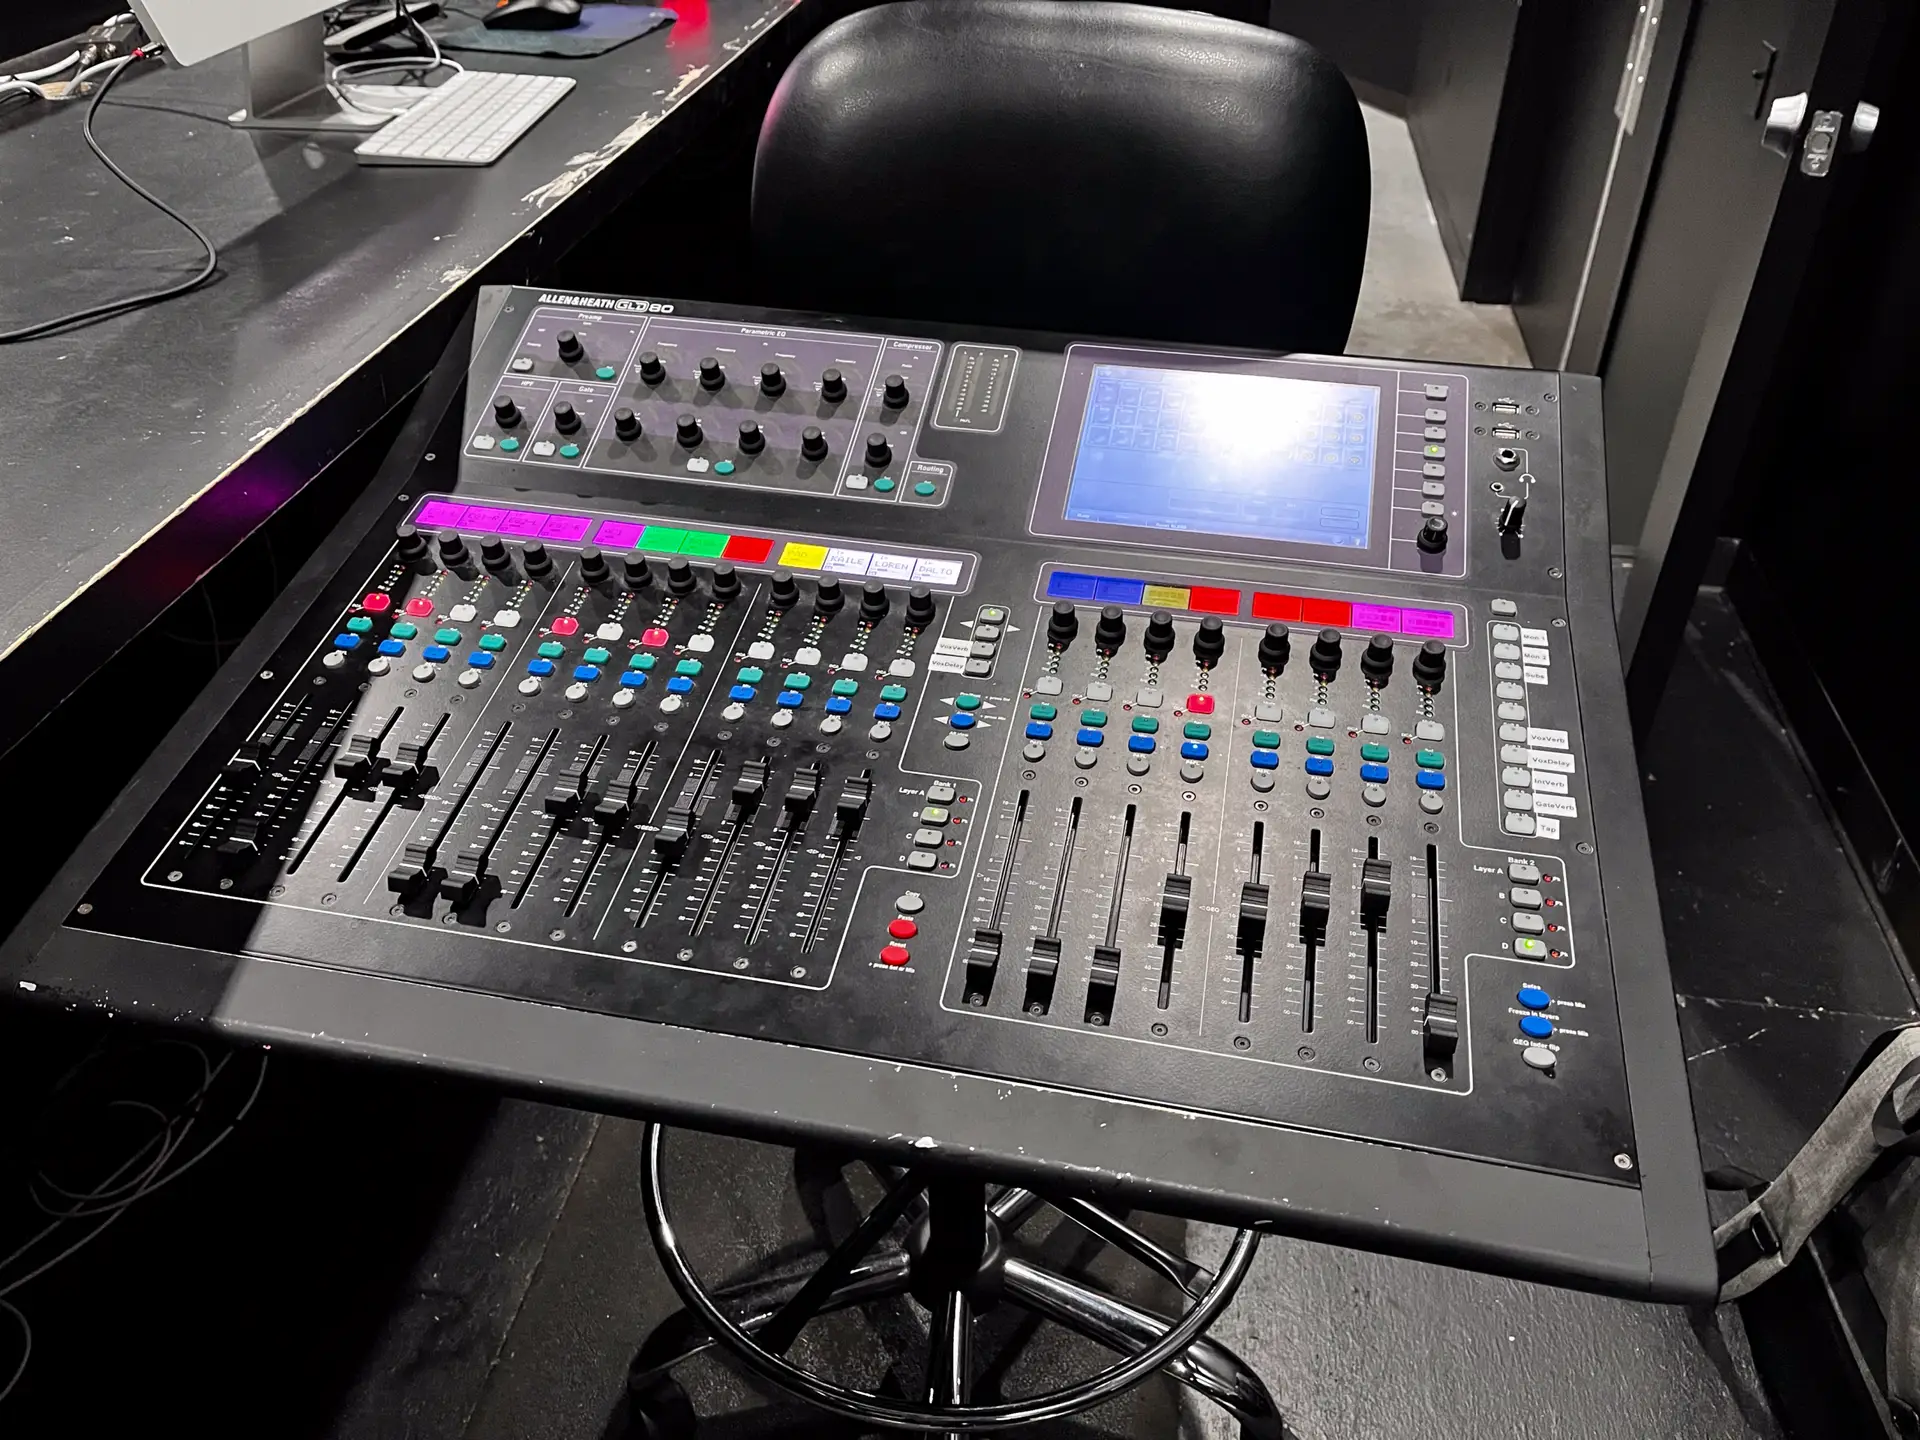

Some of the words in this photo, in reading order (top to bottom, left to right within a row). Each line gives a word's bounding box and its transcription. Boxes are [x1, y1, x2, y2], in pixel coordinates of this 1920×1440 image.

[538, 294, 615, 309] ALLEN&HEATH
[616, 300, 648, 312] GLD
[649, 304, 674, 313] 80
[578, 313, 602, 321] Preamp
[741, 327, 775, 337] Parametric
[893, 341, 933, 351] Compressor
[917, 464, 944, 474] Routing
[830, 555, 865, 565] KAILE
[874, 560, 909, 571] LOREN
[939, 643, 969, 652] VoxVerb
[932, 659, 965, 669] VoxDelay
[1531, 734, 1565, 744] VoxVerb
[1532, 756, 1571, 768] VoxDelay
[1534, 778, 1565, 788] IntVerb
[898, 787, 918, 795] Layer
[1535, 800, 1575, 811] GateVerb
[1540, 825, 1557, 833] Tap
[1507, 856, 1528, 865] Bank
[1473, 864, 1495, 874] Layer
